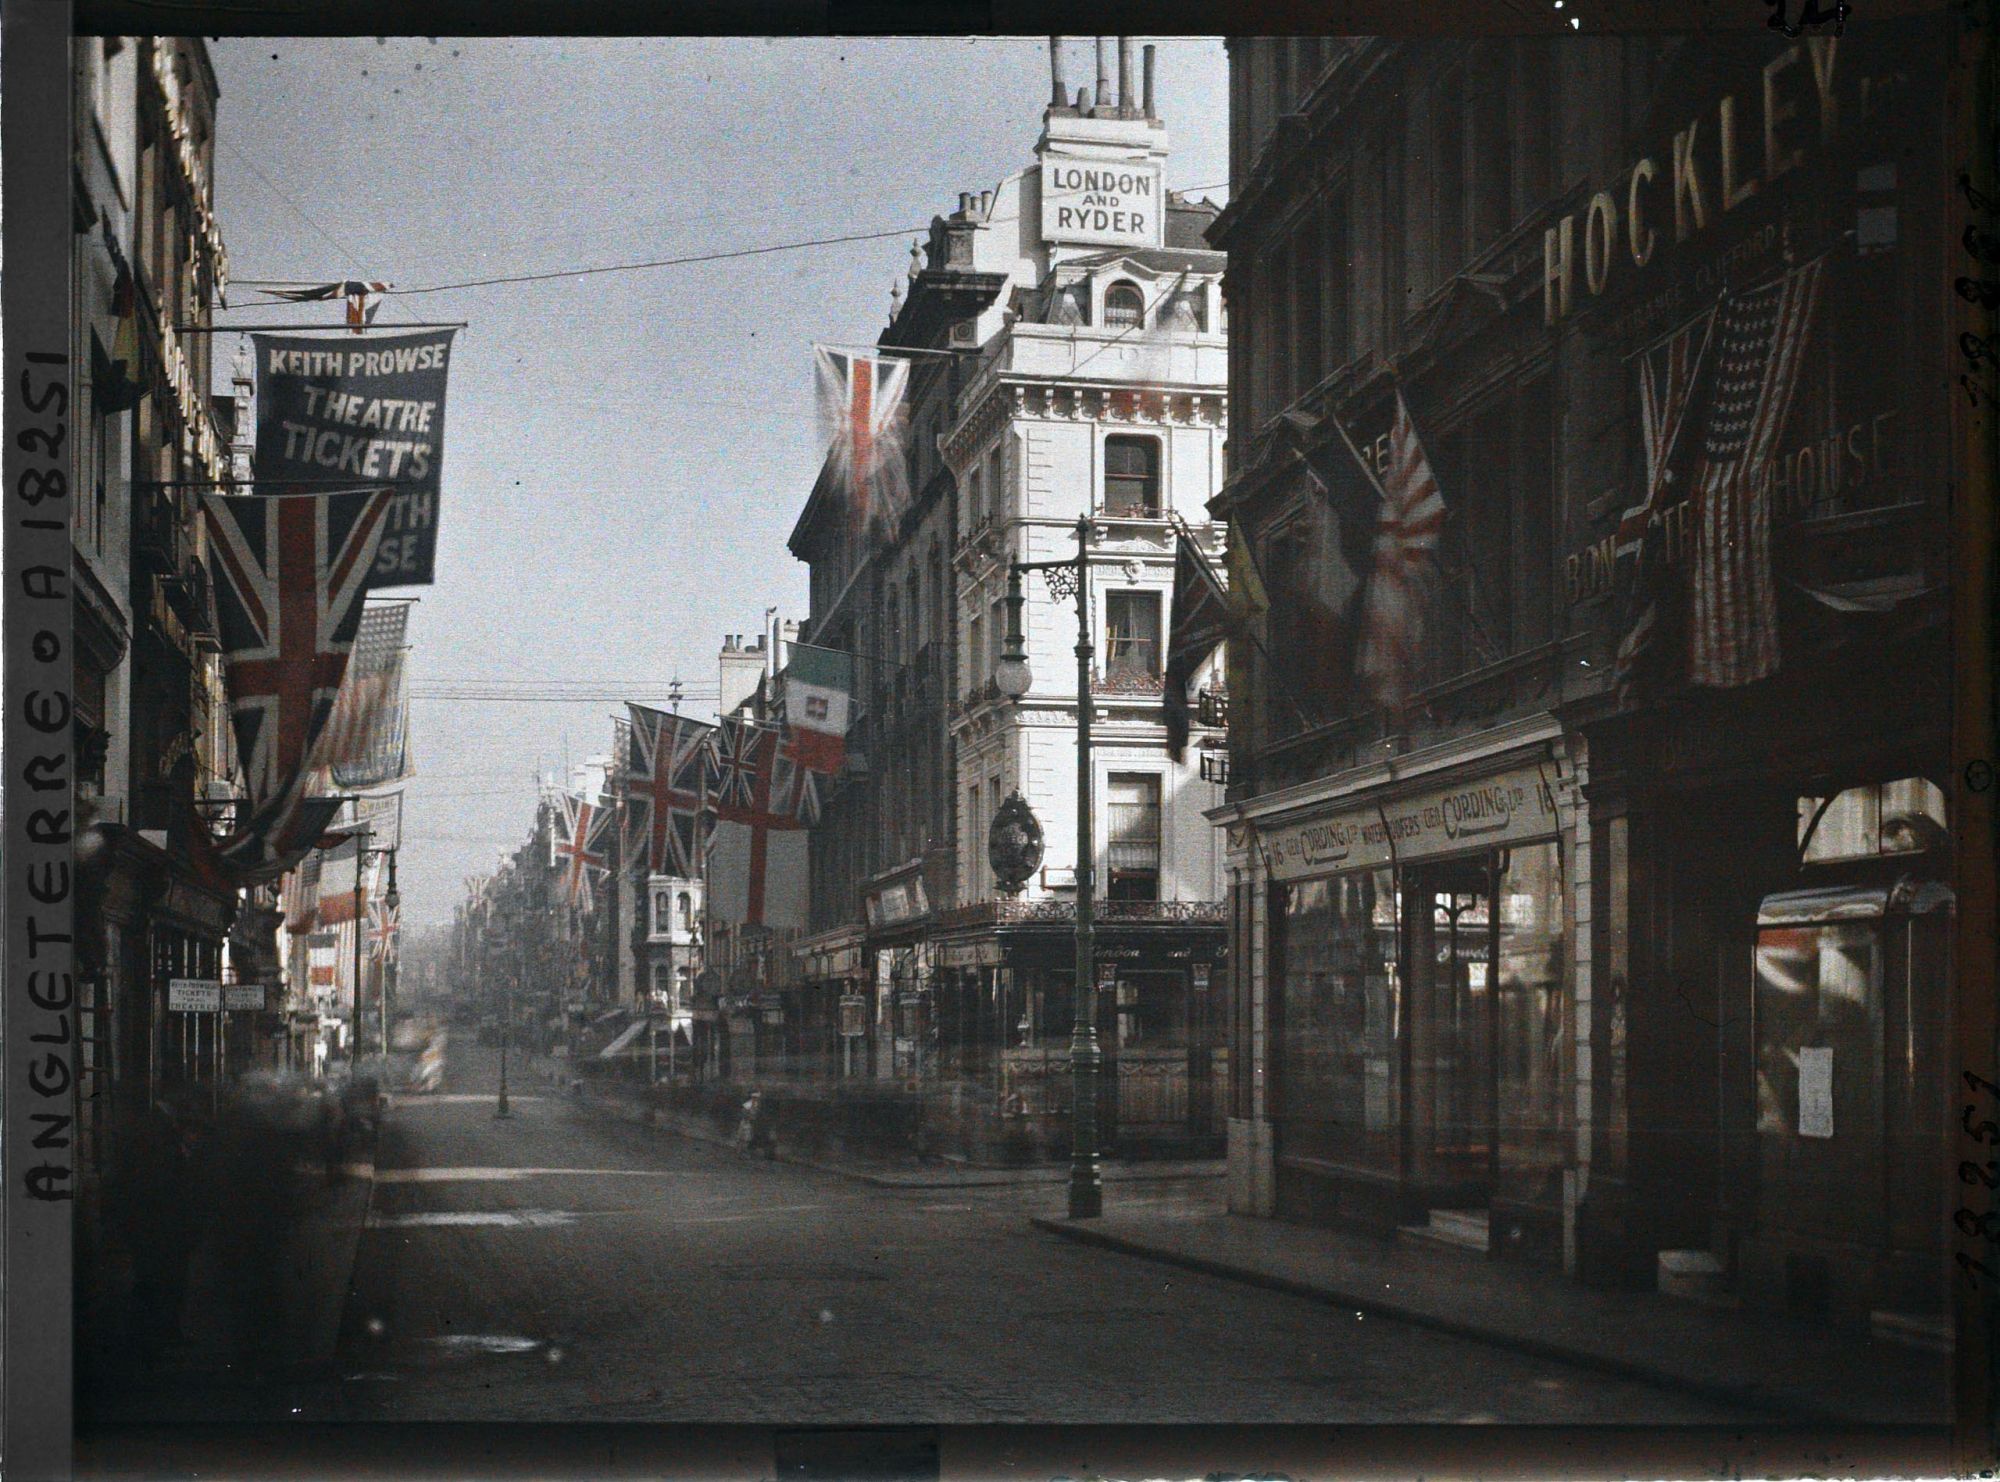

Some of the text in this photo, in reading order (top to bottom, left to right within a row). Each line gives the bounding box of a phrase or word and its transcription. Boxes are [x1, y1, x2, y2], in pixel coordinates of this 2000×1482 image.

[1053, 167, 1151, 196] LONDON
[1082, 195, 1120, 207] AND
[1544, 36, 1838, 327] HOCKLEY
[1058, 206, 1145, 234] RYDER
[269, 343, 448, 377] KEITH PROWSE
[303, 384, 436, 433] THEATRE
[282, 419, 431, 480] TICKETS
[1301, 820, 1348, 866] CORDING
[1442, 785, 1510, 840] CORDING
